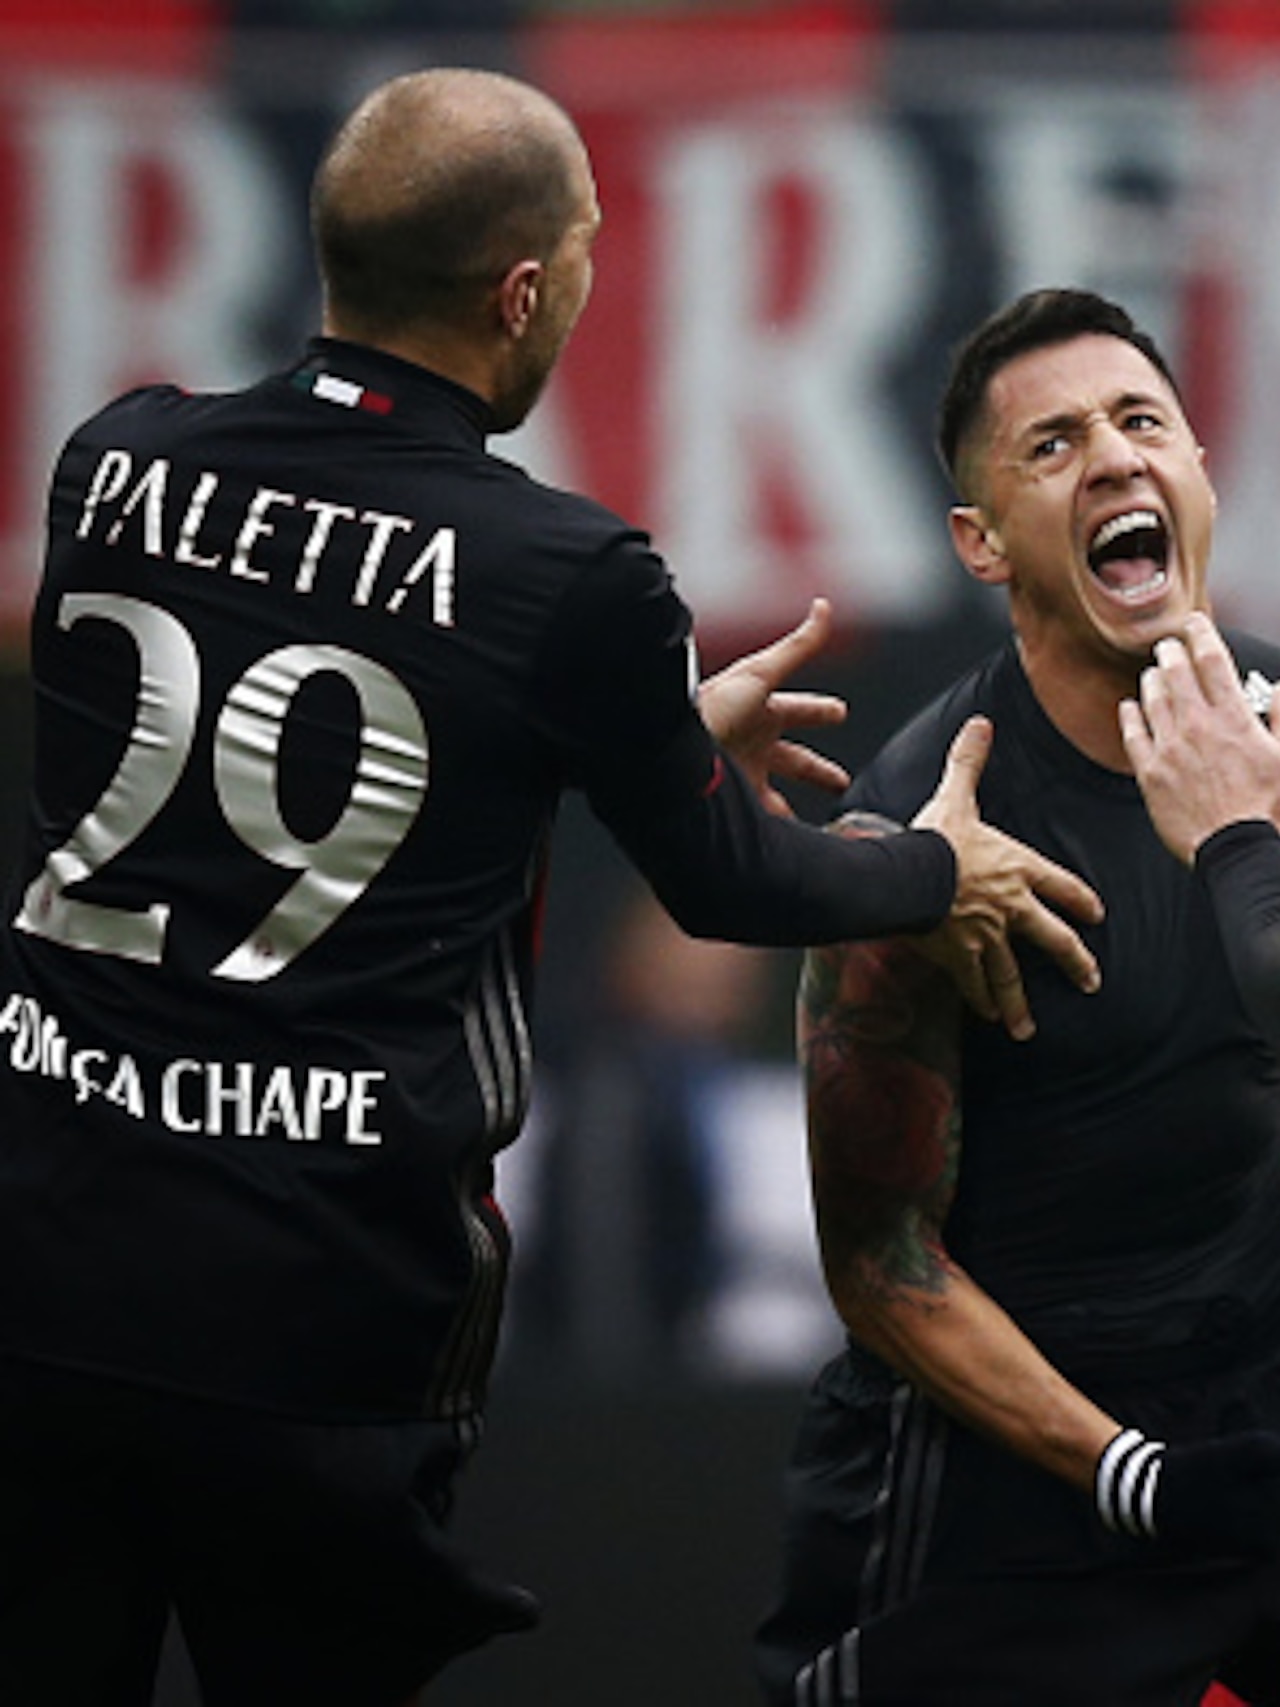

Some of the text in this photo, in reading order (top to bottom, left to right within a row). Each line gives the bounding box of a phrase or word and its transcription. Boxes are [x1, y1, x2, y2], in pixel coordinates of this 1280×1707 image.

[76, 448, 456, 628] PALETTA
[12, 591, 430, 983] 29
[161, 1058, 386, 1145] CHAPE
